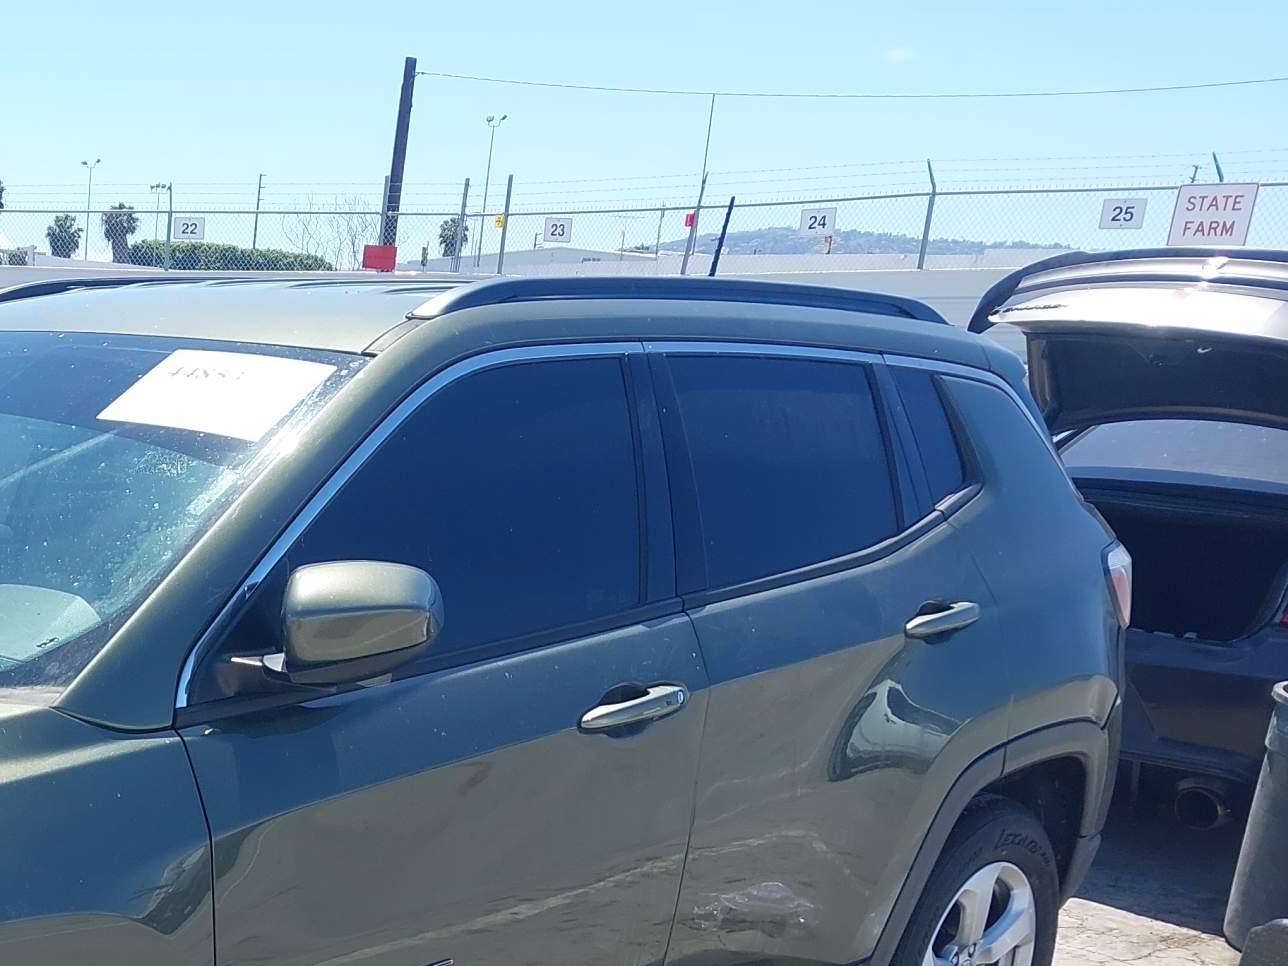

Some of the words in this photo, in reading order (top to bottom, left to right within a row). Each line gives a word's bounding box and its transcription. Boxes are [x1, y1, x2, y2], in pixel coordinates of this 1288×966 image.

[1185, 195, 1245, 212] STATE
[1111, 206, 1135, 222] 25
[181, 223, 198, 235] 22
[550, 223, 565, 237] 23
[808, 216, 827, 230] 24
[1182, 221, 1235, 237] FARM
